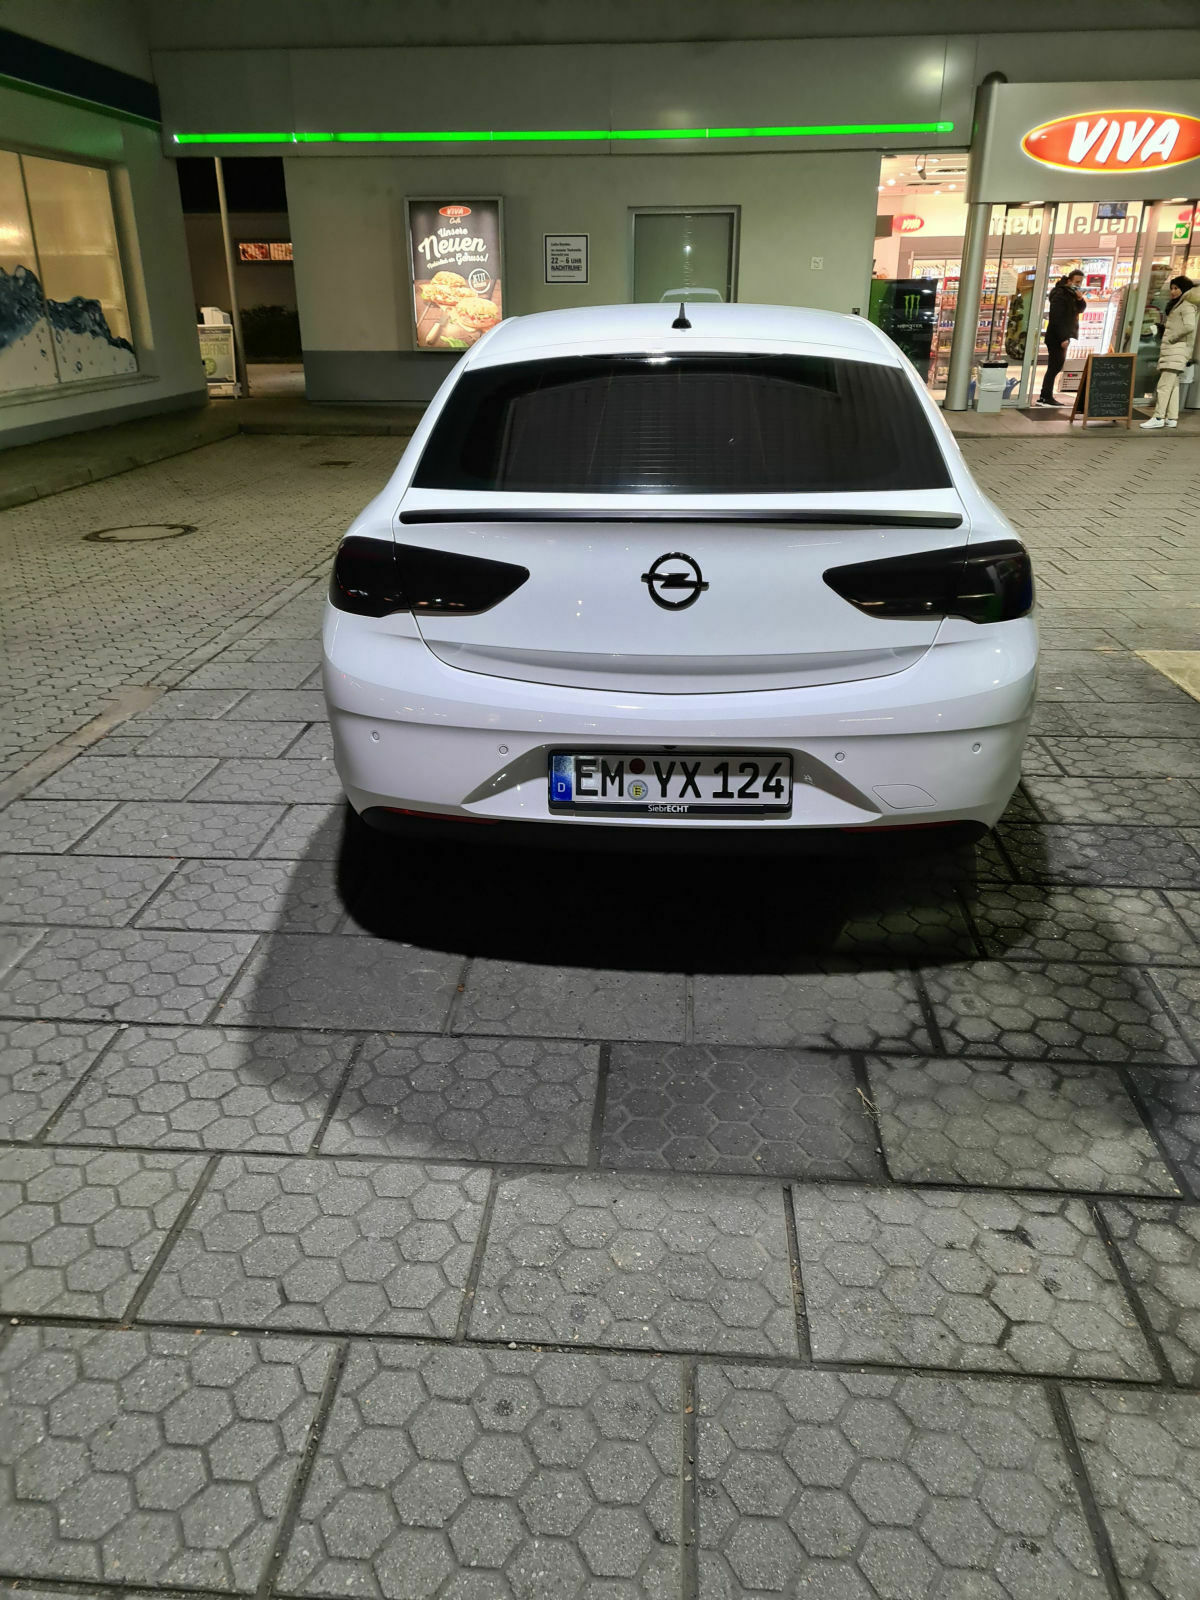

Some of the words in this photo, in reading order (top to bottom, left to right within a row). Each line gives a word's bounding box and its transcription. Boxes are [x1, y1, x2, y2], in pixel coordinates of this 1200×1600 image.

[1068, 116, 1181, 164] VIVA
[446, 207, 464, 216] VIVA
[437, 227, 469, 237] Unsere
[417, 235, 487, 260] Neuen
[557, 782, 566, 793] D
[575, 759, 625, 797] EM
[652, 761, 702, 798] YX
[712, 761, 785, 799] 124
[647, 804, 689, 813] SiebrECHT
